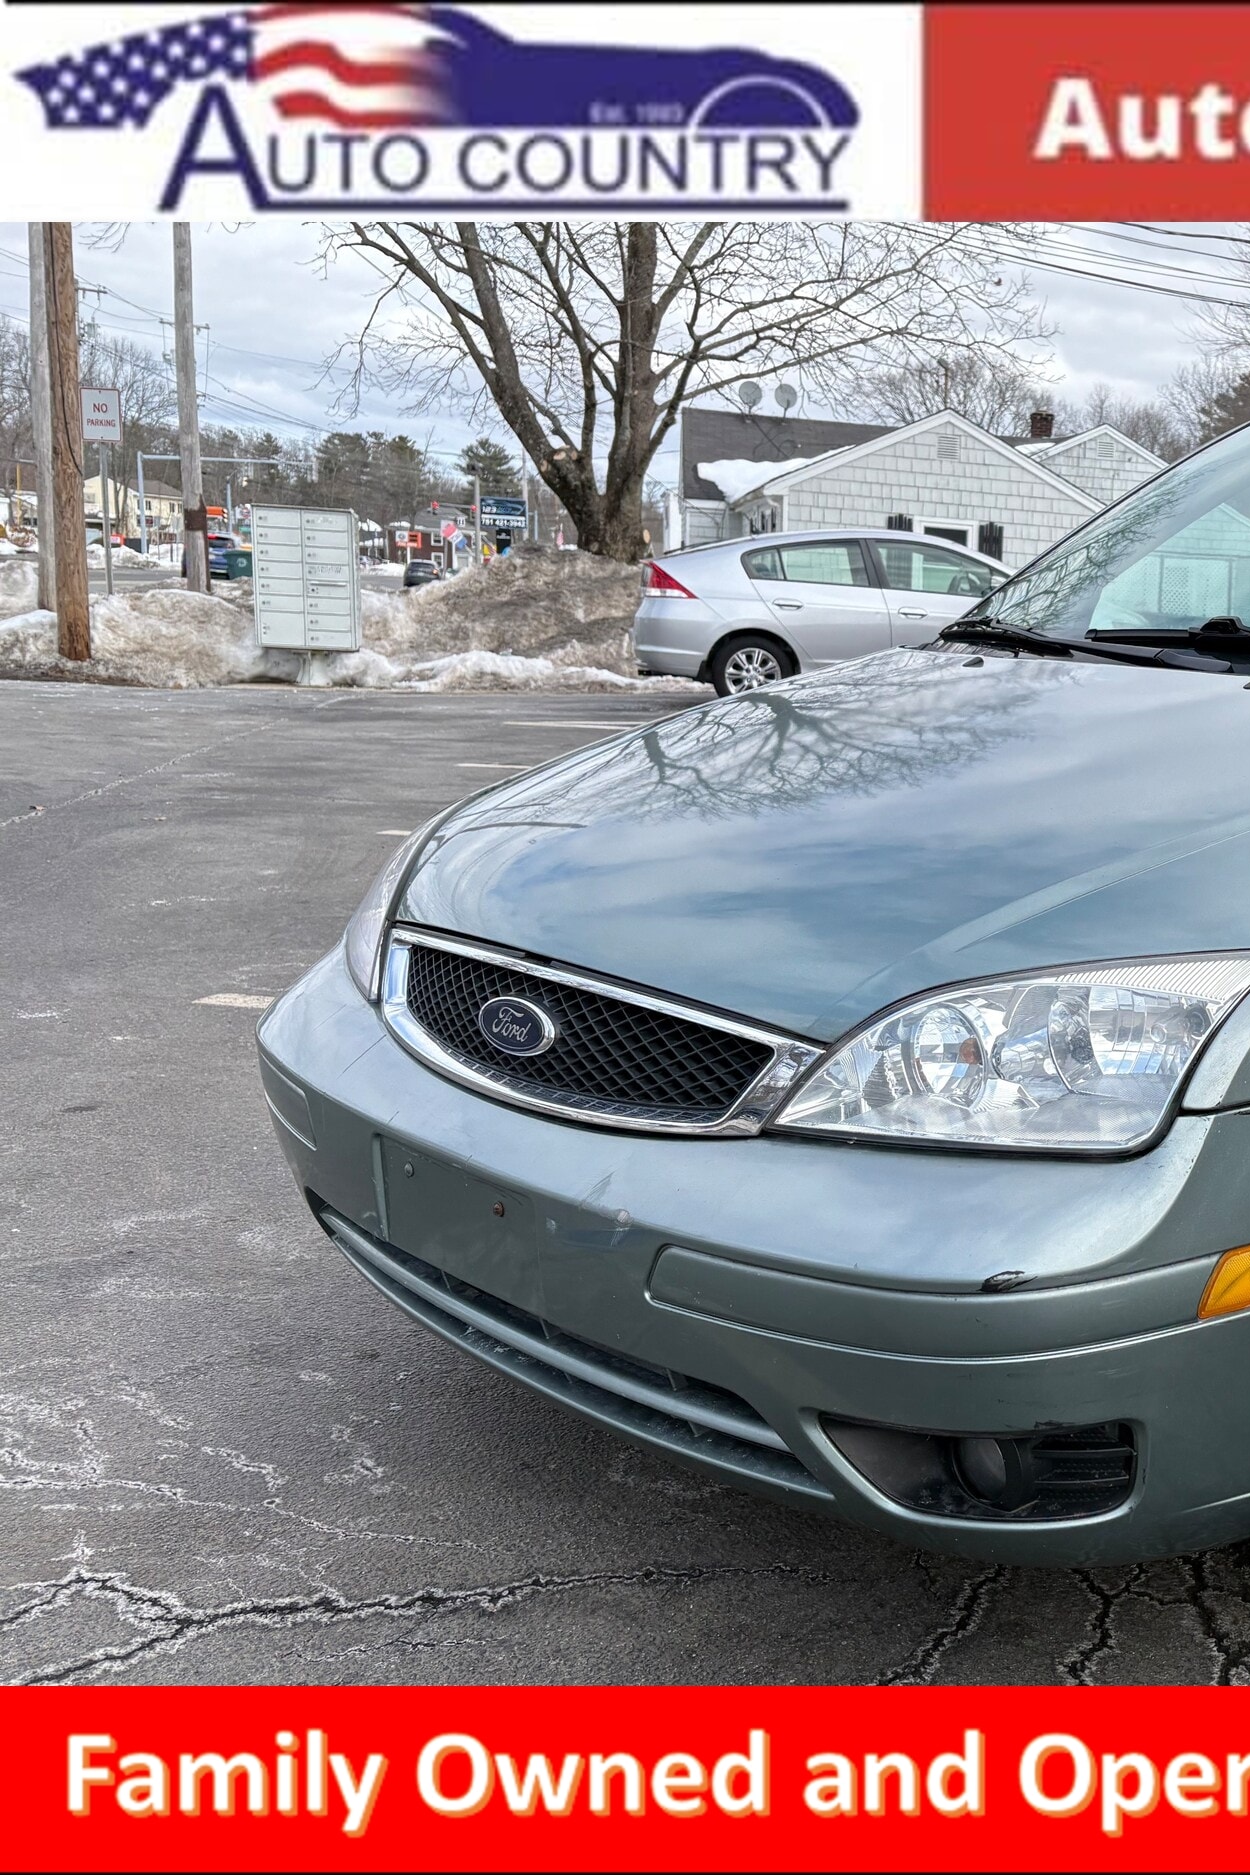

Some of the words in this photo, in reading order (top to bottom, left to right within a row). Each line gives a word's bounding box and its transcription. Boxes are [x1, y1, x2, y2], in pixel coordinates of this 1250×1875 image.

[93, 402, 108, 413] NO
[86, 418, 116, 427] PARKING
[492, 1006, 532, 1042] Ford
